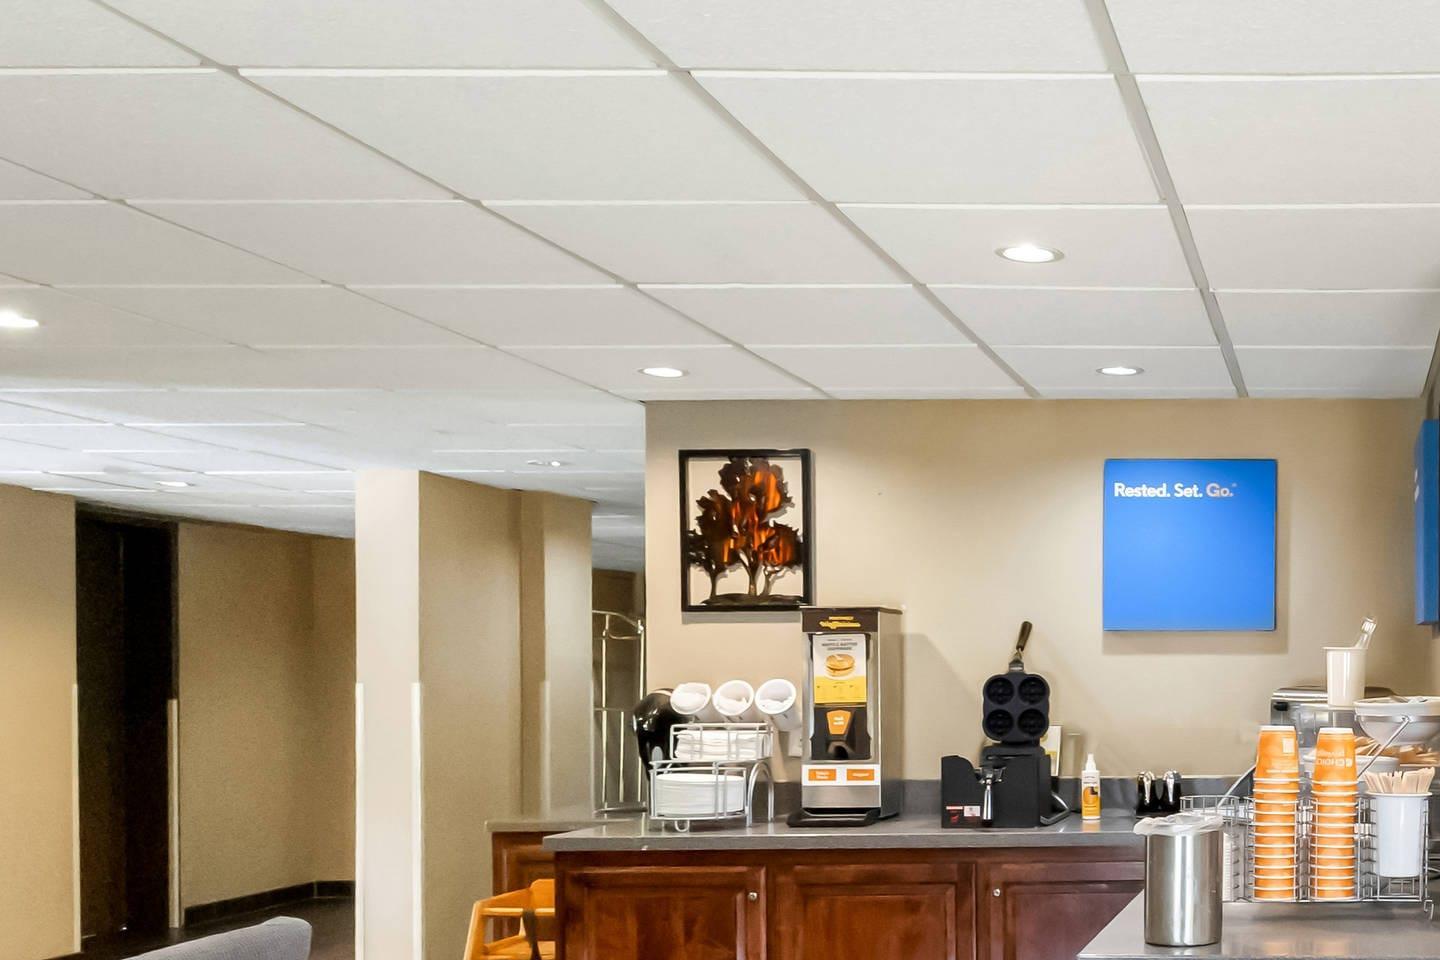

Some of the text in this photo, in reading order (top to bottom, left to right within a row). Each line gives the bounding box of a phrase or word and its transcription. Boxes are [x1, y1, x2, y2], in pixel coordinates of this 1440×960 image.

[1113, 482, 1234, 498] Rested. Set. Go.
